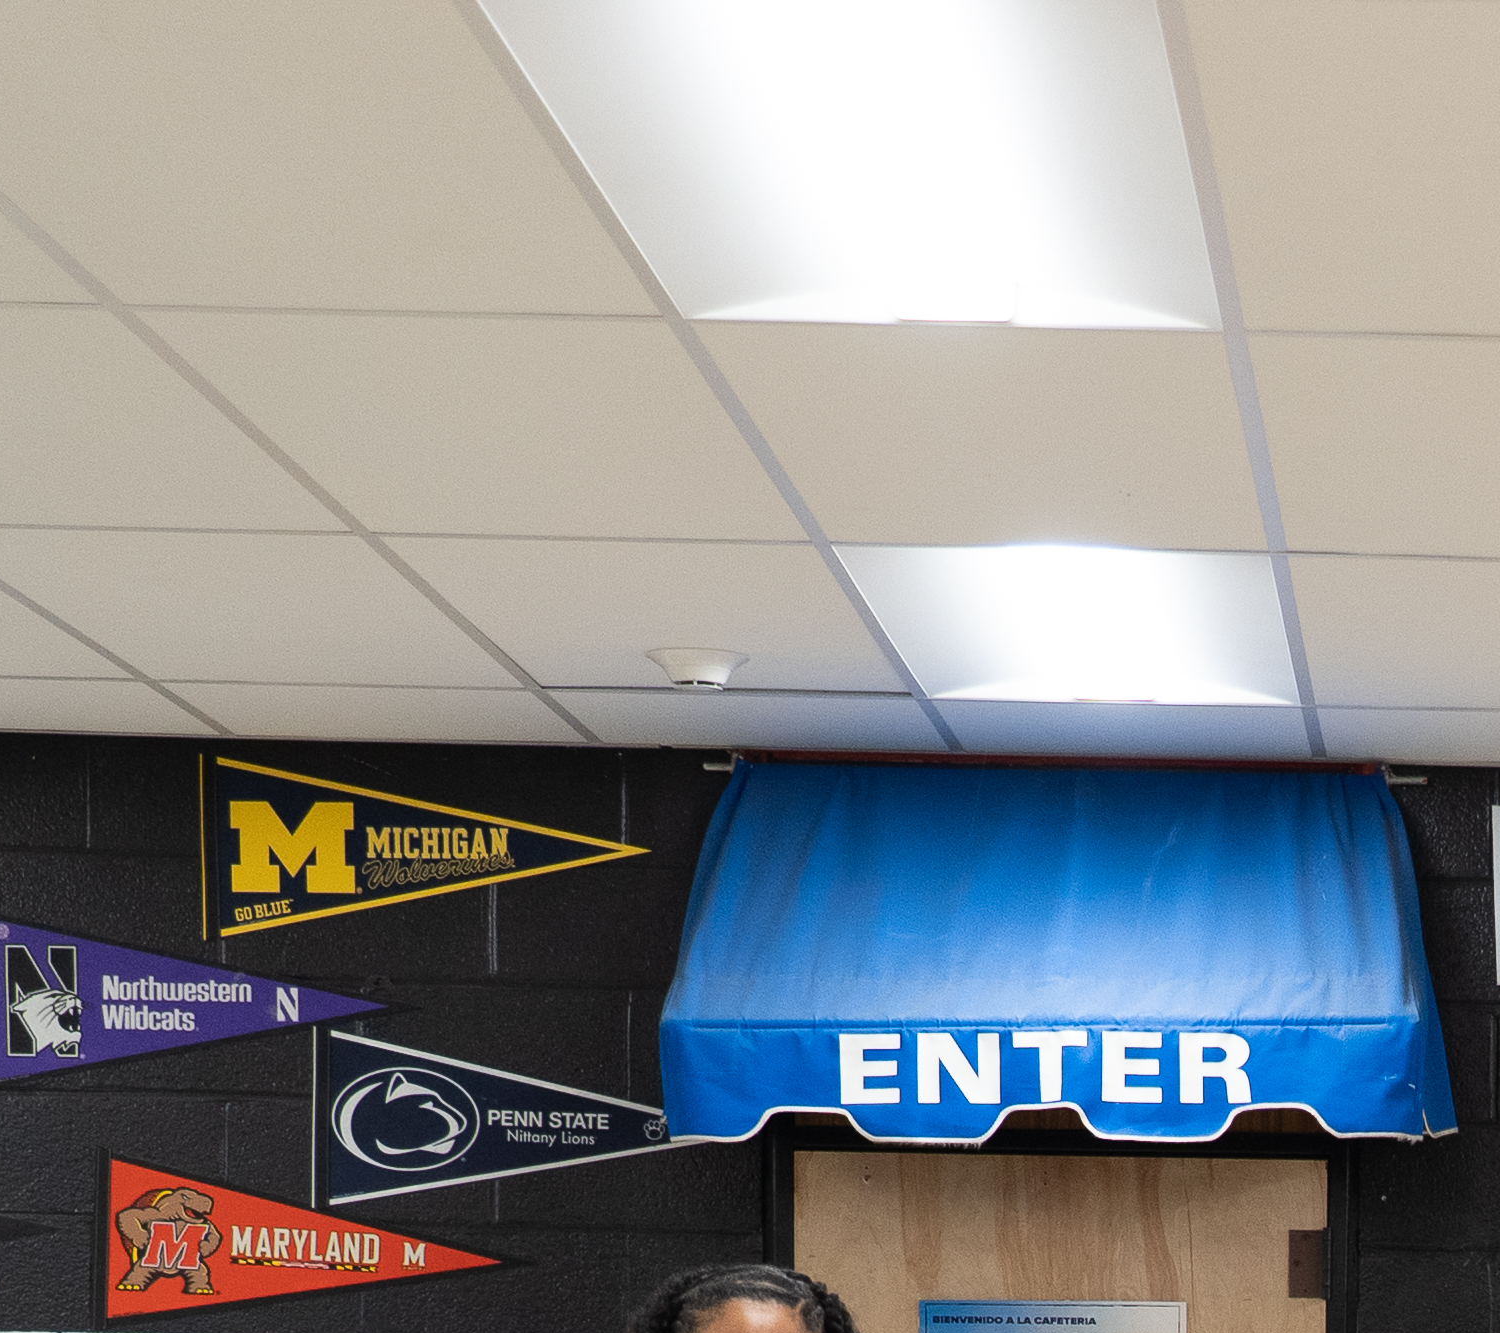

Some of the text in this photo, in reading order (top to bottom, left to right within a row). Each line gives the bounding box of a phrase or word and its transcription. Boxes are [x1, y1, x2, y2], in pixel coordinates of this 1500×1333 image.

[230, 801, 355, 893] M
[365, 827, 509, 859] MICHIGAN
[362, 851, 514, 889] Wolverines
[235, 900, 292, 922] GO BLUE
[102, 975, 252, 1003] Northwestern
[102, 1004, 196, 1031] Wildcats
[276, 988, 299, 1022] N
[839, 1030, 1253, 1106] ENTER
[487, 1110, 610, 1130] PENN STATE
[507, 1129, 595, 1147] Nittany Lions
[141, 1221, 209, 1270] M
[231, 1225, 380, 1265] MARYLAND
[403, 1242, 426, 1267] M
[932, 1315, 1097, 1326] BIENVENIDO A LA CAFETERIA
